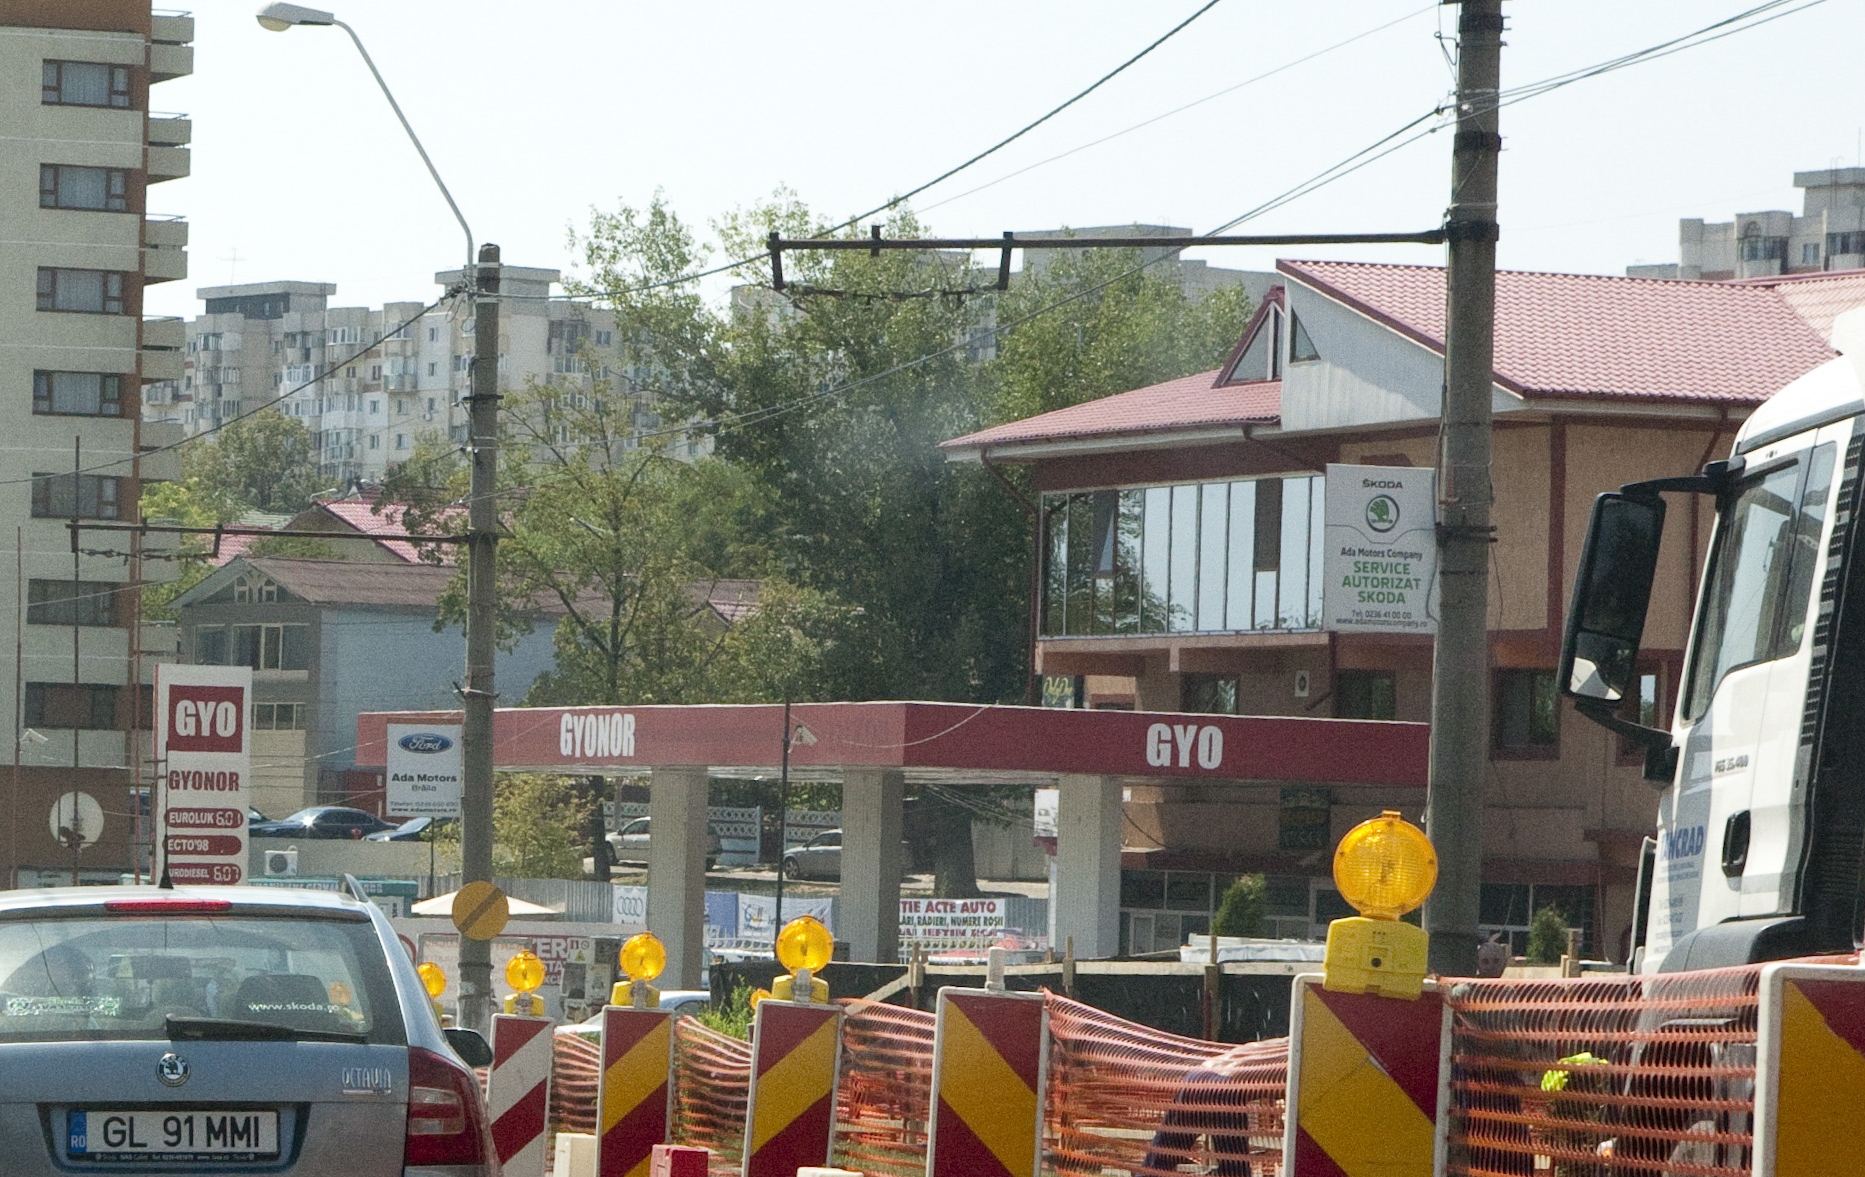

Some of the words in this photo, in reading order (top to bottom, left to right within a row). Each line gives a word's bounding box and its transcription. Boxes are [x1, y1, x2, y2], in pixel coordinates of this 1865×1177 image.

[1362, 478, 1403, 489] ŠKODA
[1340, 547, 1356, 557] Ada
[1358, 548, 1385, 558] Motors
[1387, 549, 1423, 561] Company
[1353, 560, 1411, 575] SERVICE
[1341, 576, 1421, 590] AUTORIZAT
[1357, 590, 1406, 604] SKODA
[175, 699, 237, 738] GYO
[559, 712, 635, 758] GYONOR
[409, 735, 442, 750] Ford
[1146, 722, 1224, 770] GYO
[168, 769, 241, 791] GYONOR
[392, 773, 414, 782] Ada
[417, 773, 458, 783] Motors
[169, 811, 214, 825] EUROLUK
[166, 867, 210, 879] URODIESEL
[925, 900, 956, 913] ACTE
[960, 900, 997, 914] AUTO
[248, 1002, 340, 1012] www.skoda.ro
[342, 1067, 391, 1089] OCTAVIA
[70, 1134, 86, 1148] RO
[102, 1115, 148, 1148] GL
[162, 1115, 195, 1148] 91
[205, 1115, 259, 1148] MMI
